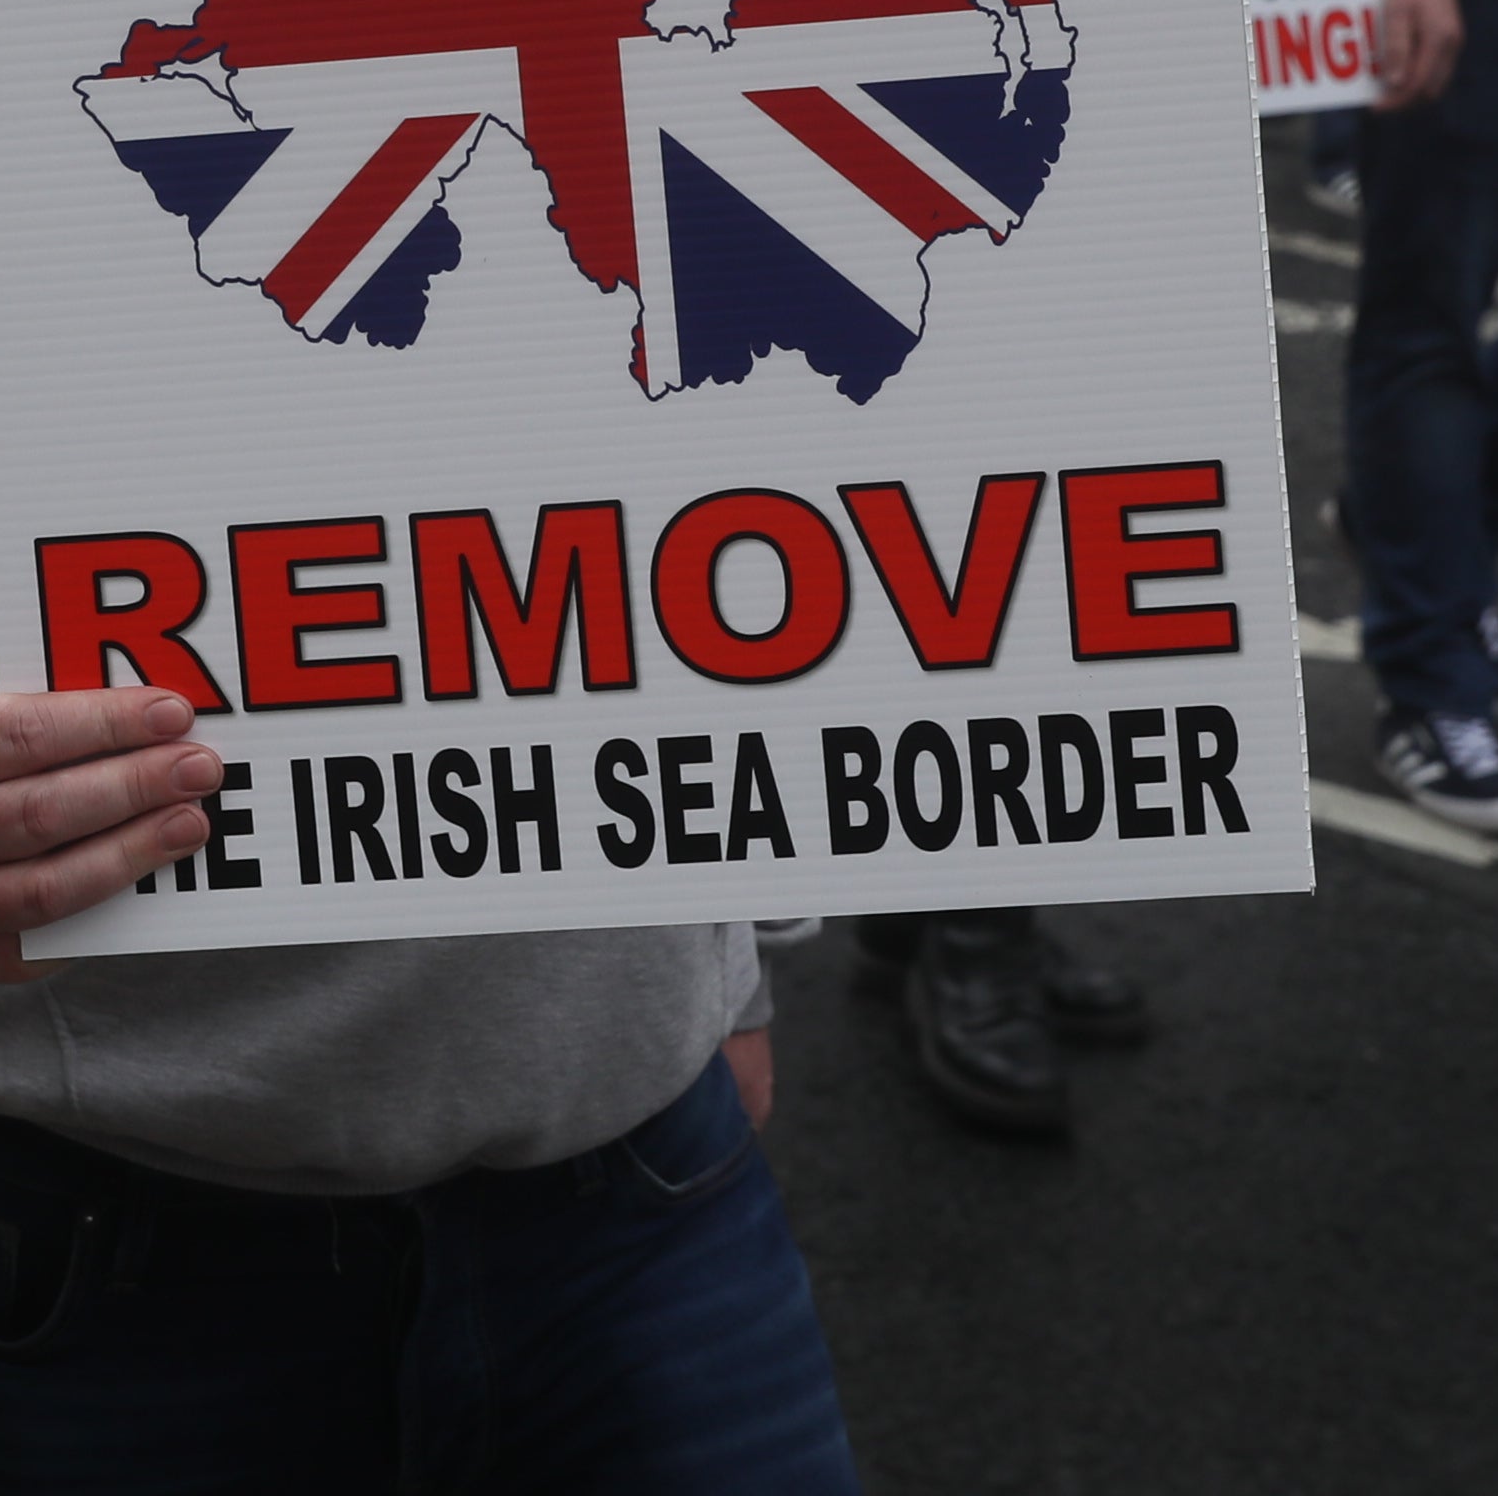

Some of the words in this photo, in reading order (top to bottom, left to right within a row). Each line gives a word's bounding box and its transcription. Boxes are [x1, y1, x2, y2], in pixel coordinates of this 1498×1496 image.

[1253, 7, 1383, 89] ING!
[34, 459, 1241, 714] REMOVE
[301, 743, 563, 886] IRISH
[594, 730, 796, 868] SEA
[822, 704, 1251, 857] BORDER
